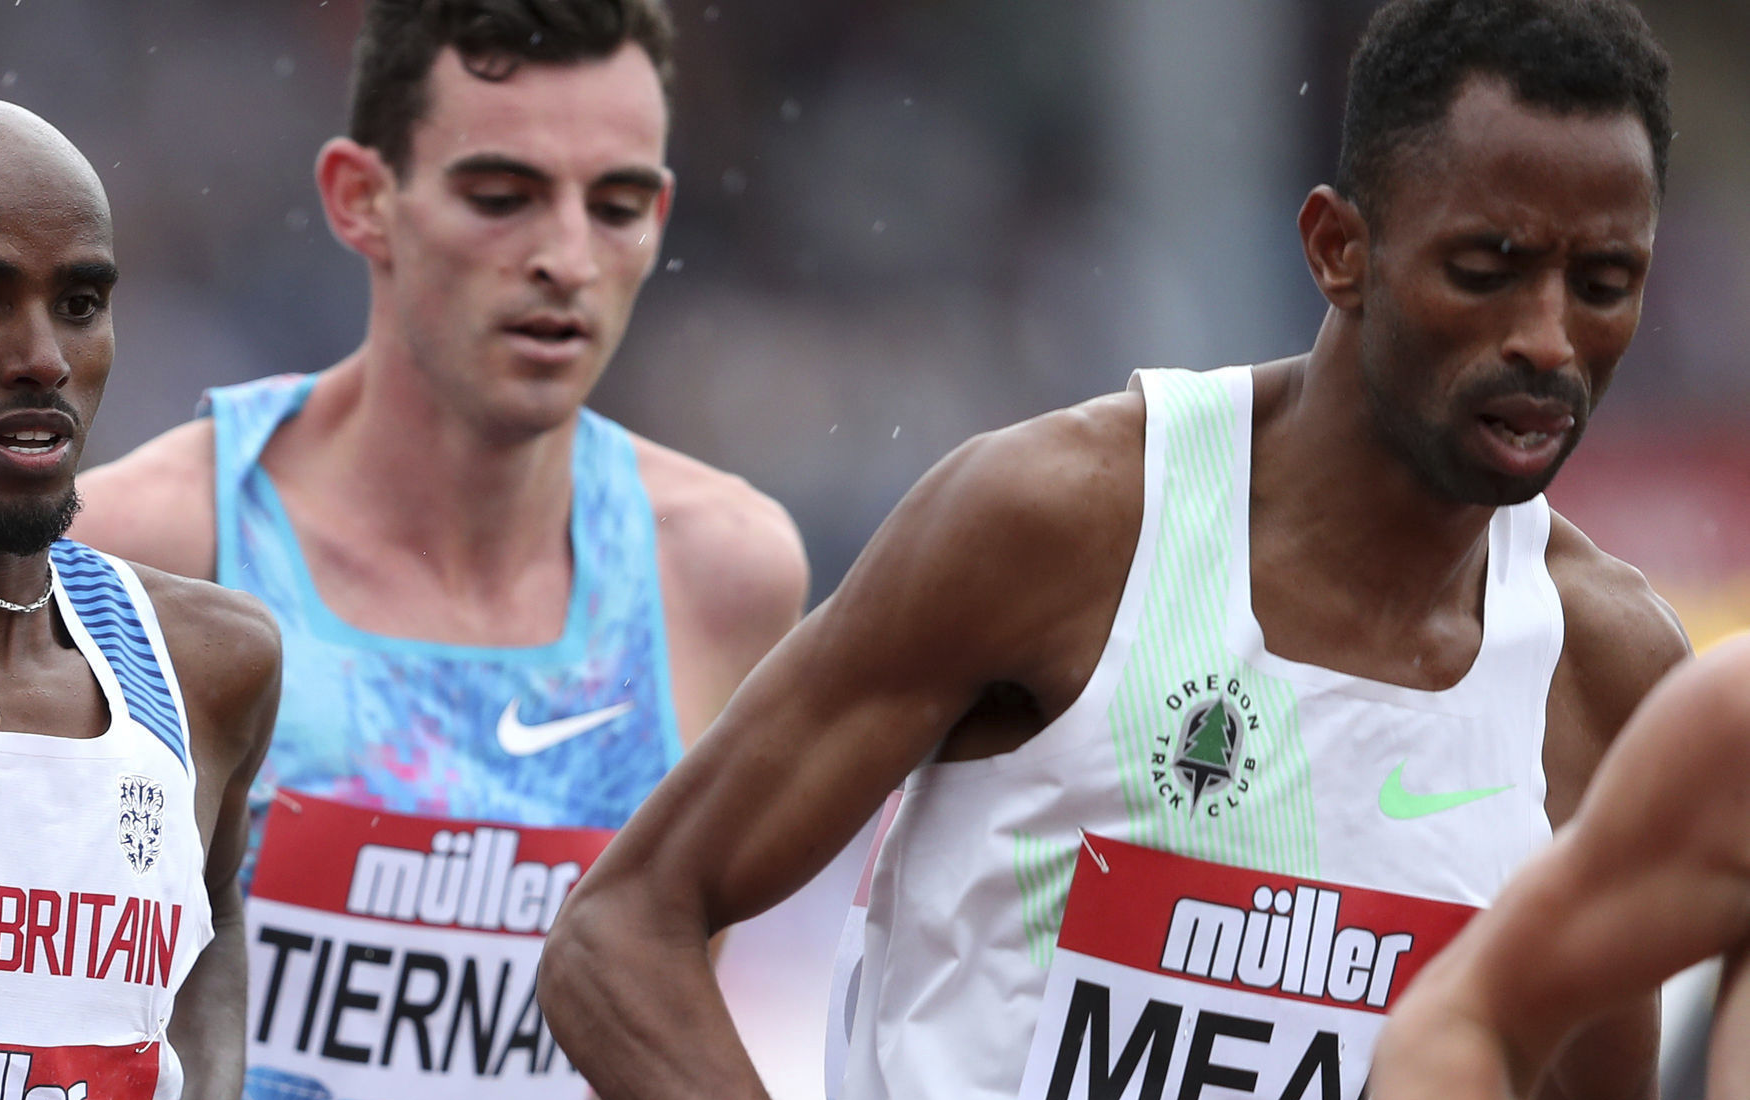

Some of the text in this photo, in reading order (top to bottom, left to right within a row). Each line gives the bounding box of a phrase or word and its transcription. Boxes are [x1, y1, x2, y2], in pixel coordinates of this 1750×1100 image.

[1166, 674, 1259, 730] OREGON
[1152, 735, 1256, 817] TRACK CLUB
[348, 827, 582, 935] müller
[1159, 885, 1414, 1009] müller
[255, 926, 580, 1078] TIERNA
